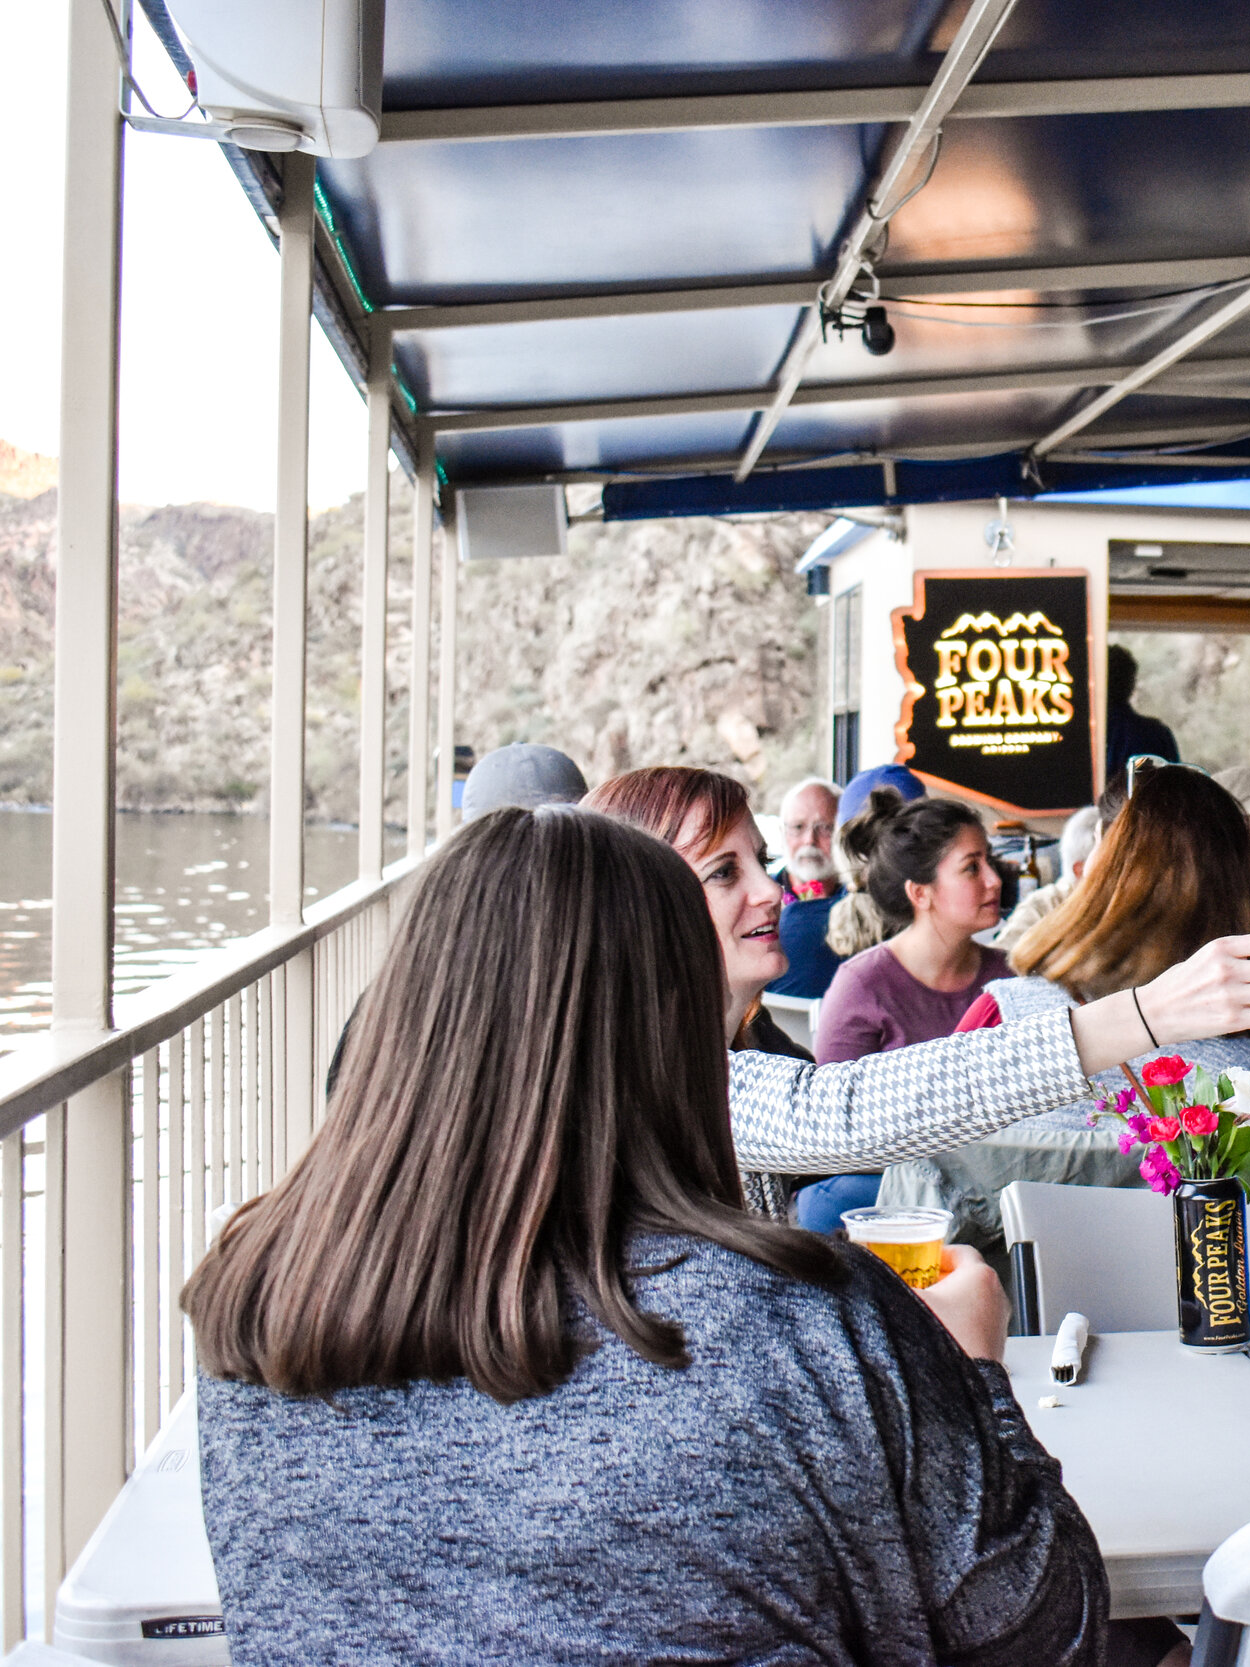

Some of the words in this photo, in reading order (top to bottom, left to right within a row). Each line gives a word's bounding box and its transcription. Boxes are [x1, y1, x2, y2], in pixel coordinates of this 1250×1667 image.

[933, 637, 1073, 688] FOUR
[935, 678, 1074, 728] PEAKS
[1204, 1199, 1237, 1268] PEAKS
[1208, 1270, 1241, 1328] FOUR
[1234, 1258, 1249, 1314] Golden
[155, 1620, 223, 1635] LIFETIME
